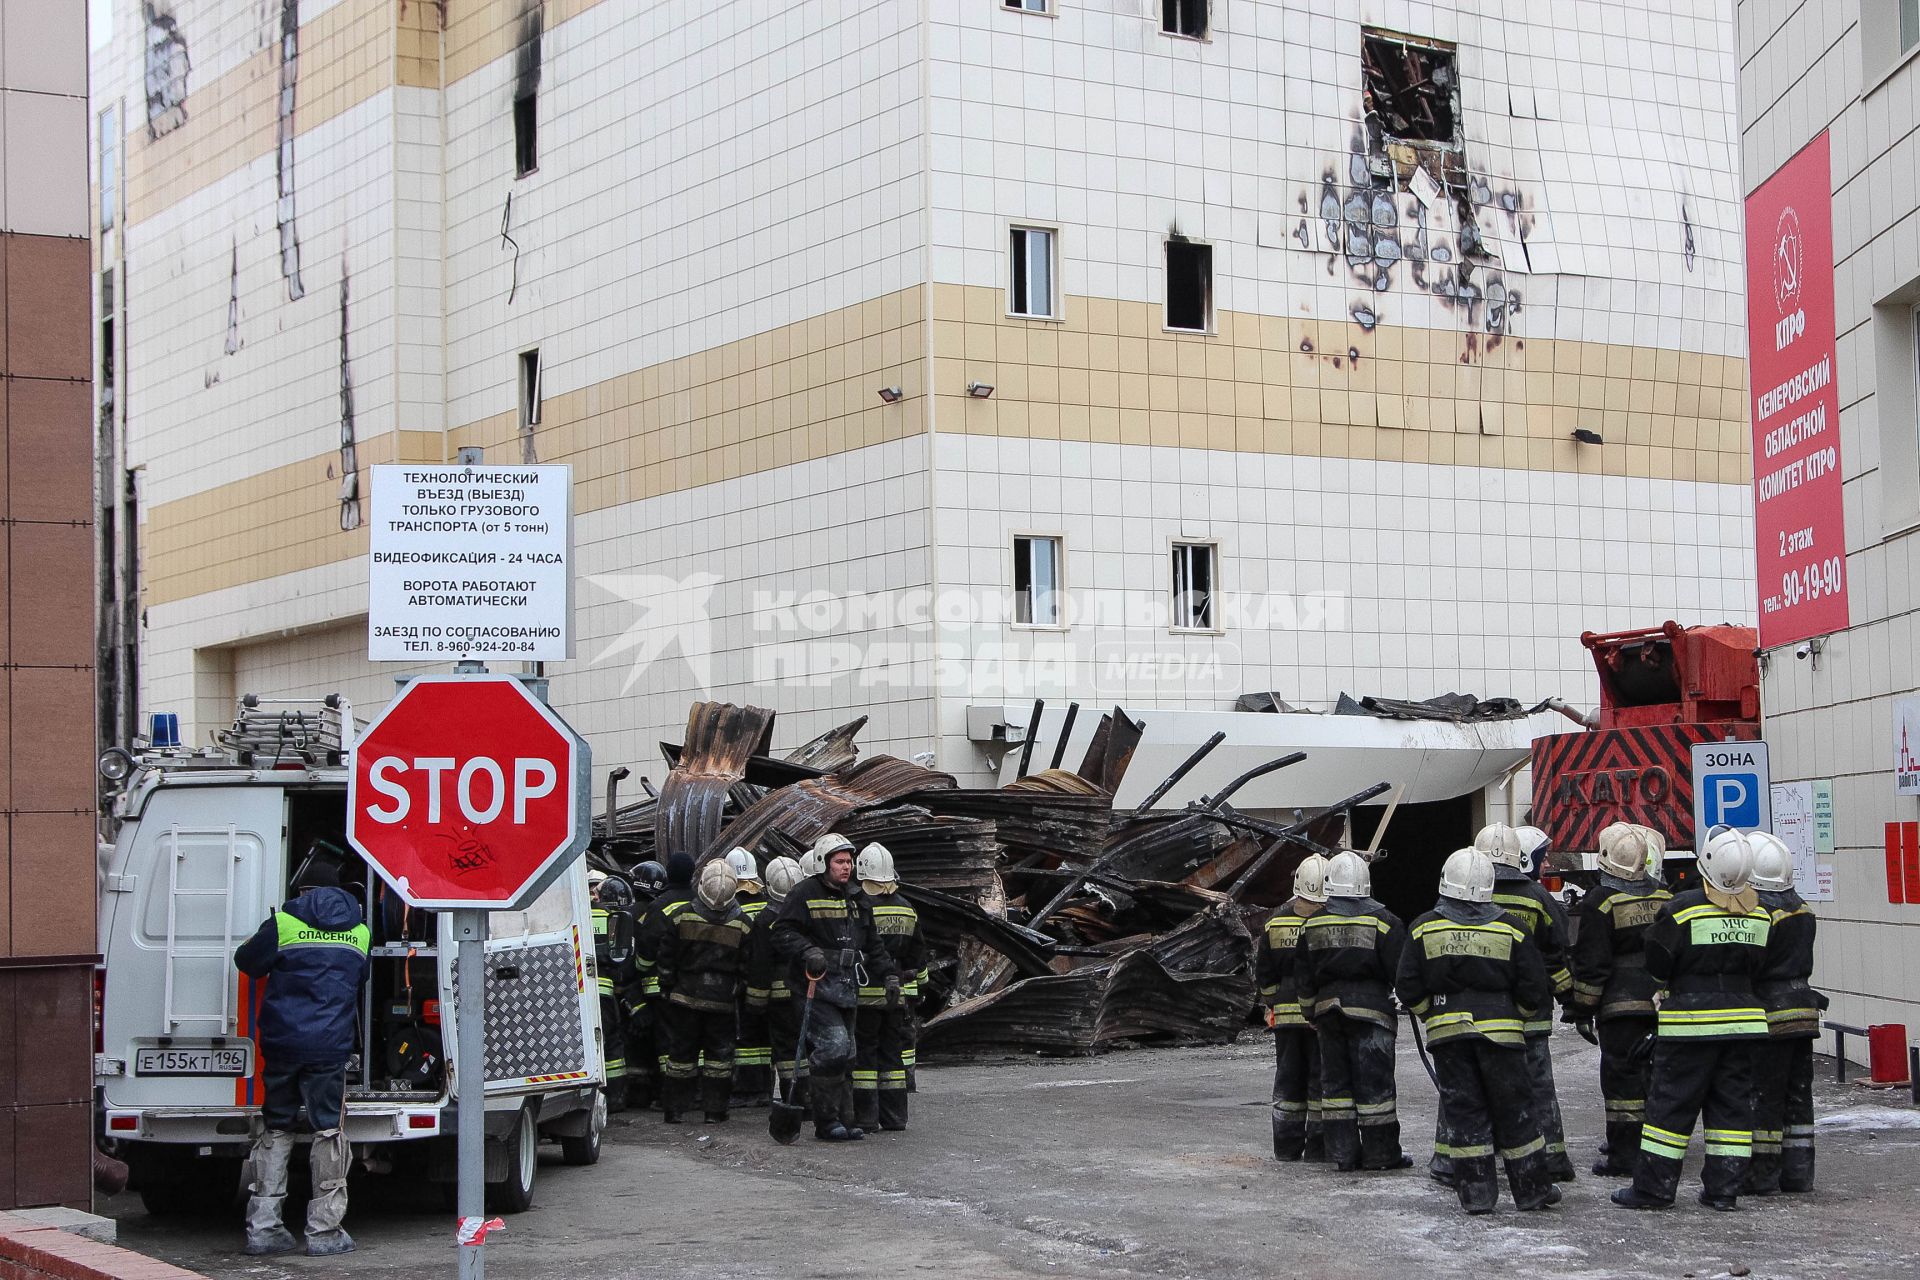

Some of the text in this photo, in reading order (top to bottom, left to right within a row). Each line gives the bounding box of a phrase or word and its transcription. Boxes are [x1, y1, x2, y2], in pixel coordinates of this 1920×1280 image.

[1775, 307, 1806, 352] КПРФ
[1757, 352, 1831, 422] КЕМЕРОВСКИЙ
[1764, 400, 1826, 459] ОБЛАСТНОЙ
[403, 471, 539, 484] ТЕХНОЛОГИЧЕСКИЙ
[1758, 445, 1836, 503] КОМИТЕТ КПРФ
[417, 489, 525, 502] ВЪЕЗД (ВЫЕЗД)
[402, 504, 540, 516] ТОЛЬКО ГРУЗОВОГО
[389, 521, 549, 534] ТРАНСПОРТА (от 5 тонн)
[1779, 526, 1814, 557] 2 этаж
[373, 552, 496, 565] ВИДЕОФИКСАЦИЯ
[508, 552, 523, 564] 24
[526, 552, 563, 564] ЧАСА
[403, 580, 537, 592] ВОРОТА РАБОТАЮТ
[1783, 555, 1841, 608] 90-19-90
[408, 595, 527, 606] АВТОМАТИЧЕСКИ
[374, 626, 561, 638] ЗАЕЗД ПО СОГЛАСОВАНИЮ
[403, 641, 536, 652] ТЕЛ. 8-960-924-20-84
[1705, 752, 1755, 767] ЗОНА
[366, 756, 557, 825] STOP
[1716, 779, 1747, 824] P
[1721, 919, 1749, 930] МЧС
[298, 930, 359, 945] СПАСЕНИЯ
[214, 1052, 240, 1065] 196
